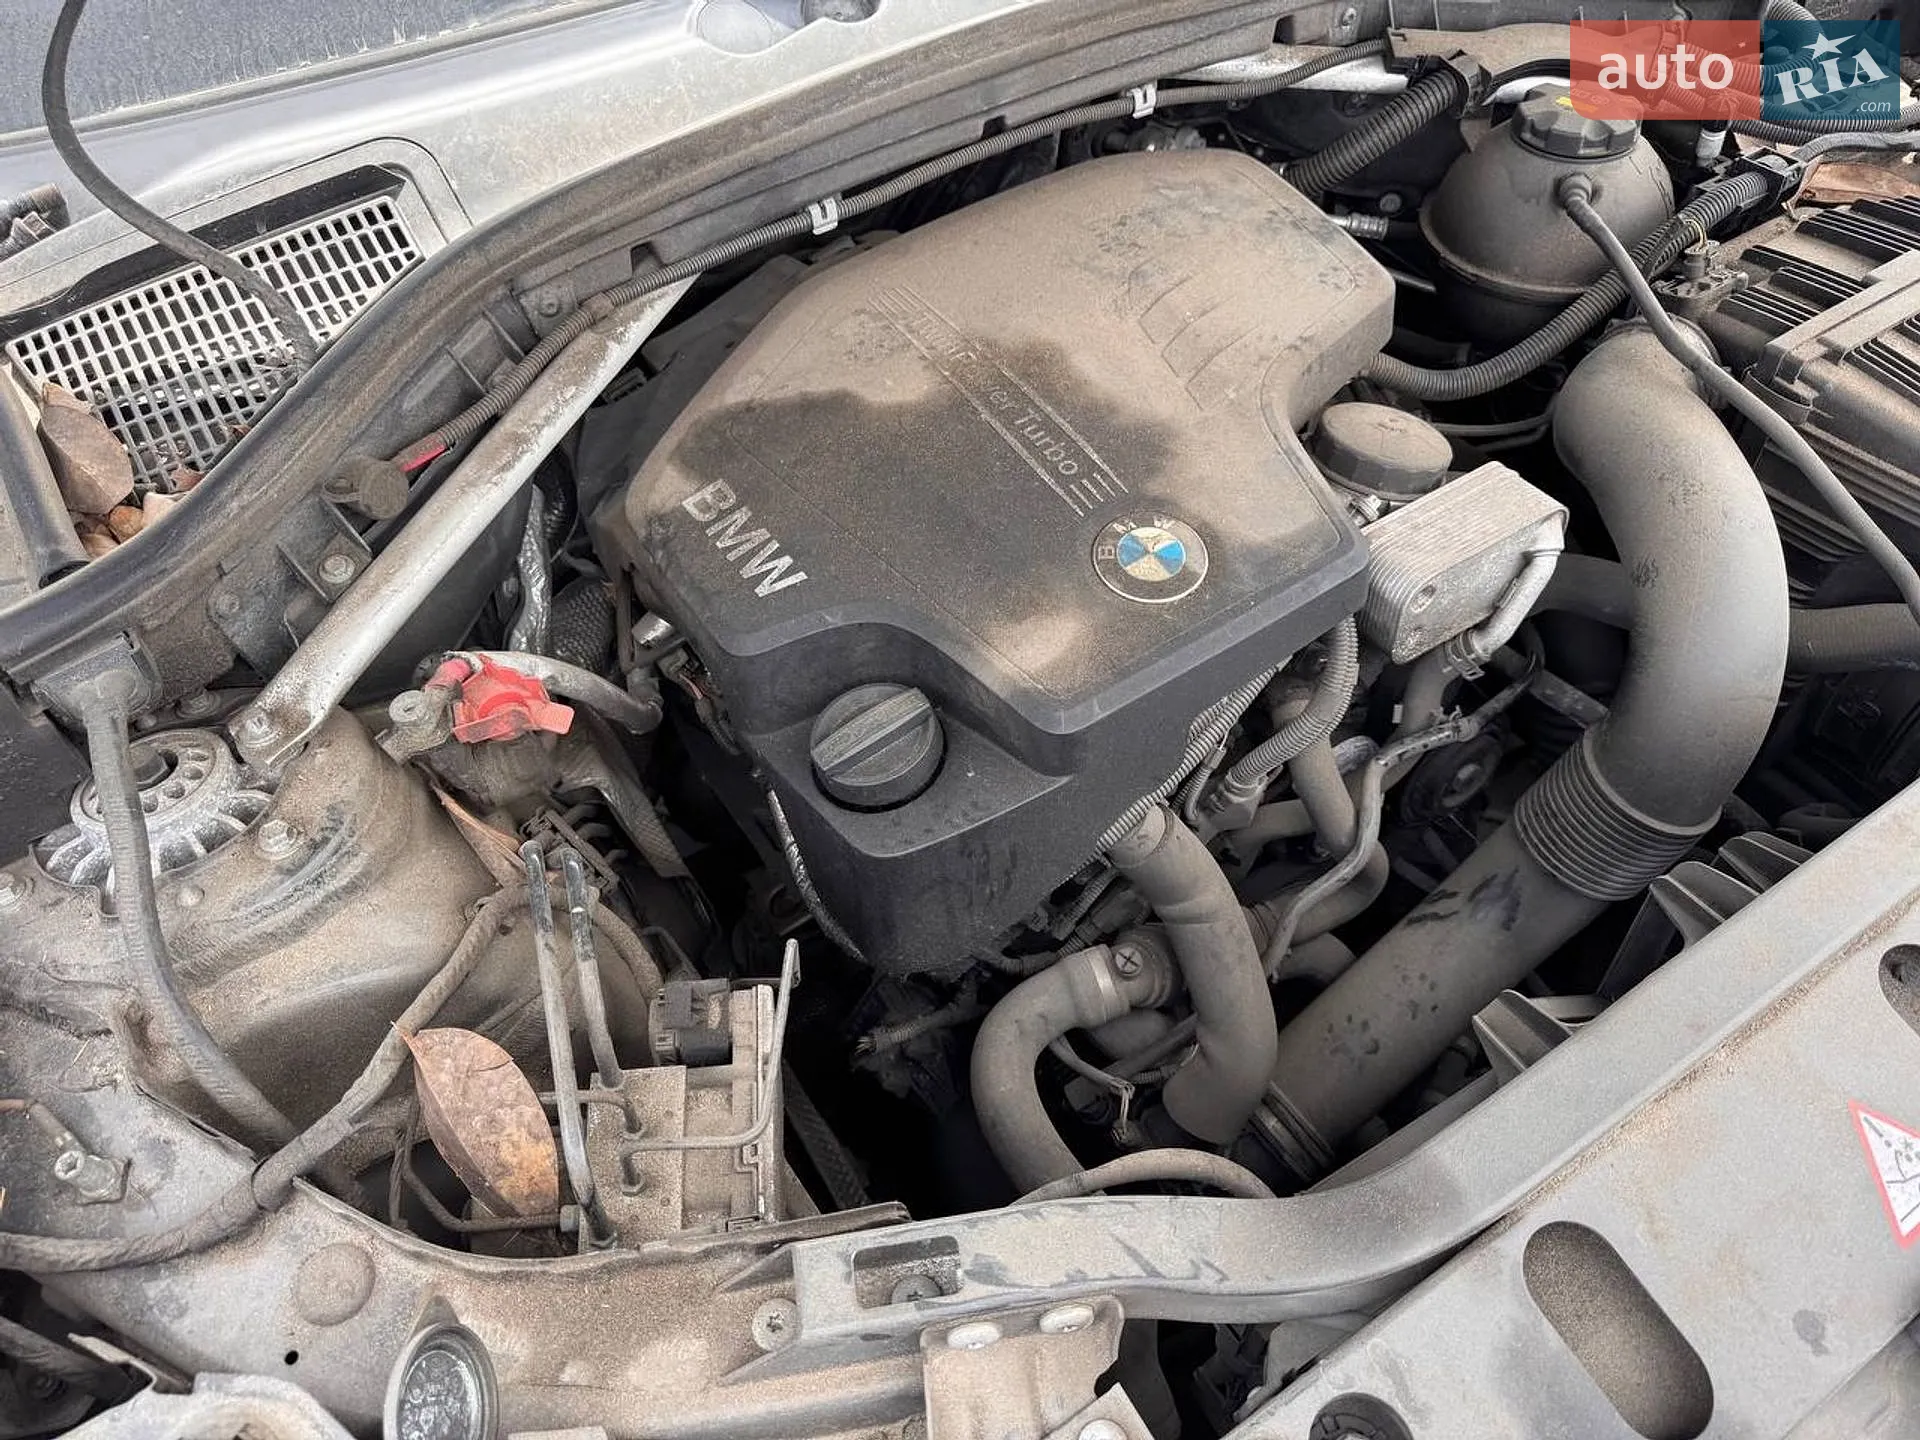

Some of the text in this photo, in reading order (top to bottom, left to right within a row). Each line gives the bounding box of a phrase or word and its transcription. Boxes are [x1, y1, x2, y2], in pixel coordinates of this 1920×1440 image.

[908, 311, 1079, 476] TwinPer Turbo
[681, 479, 809, 598] BMW
